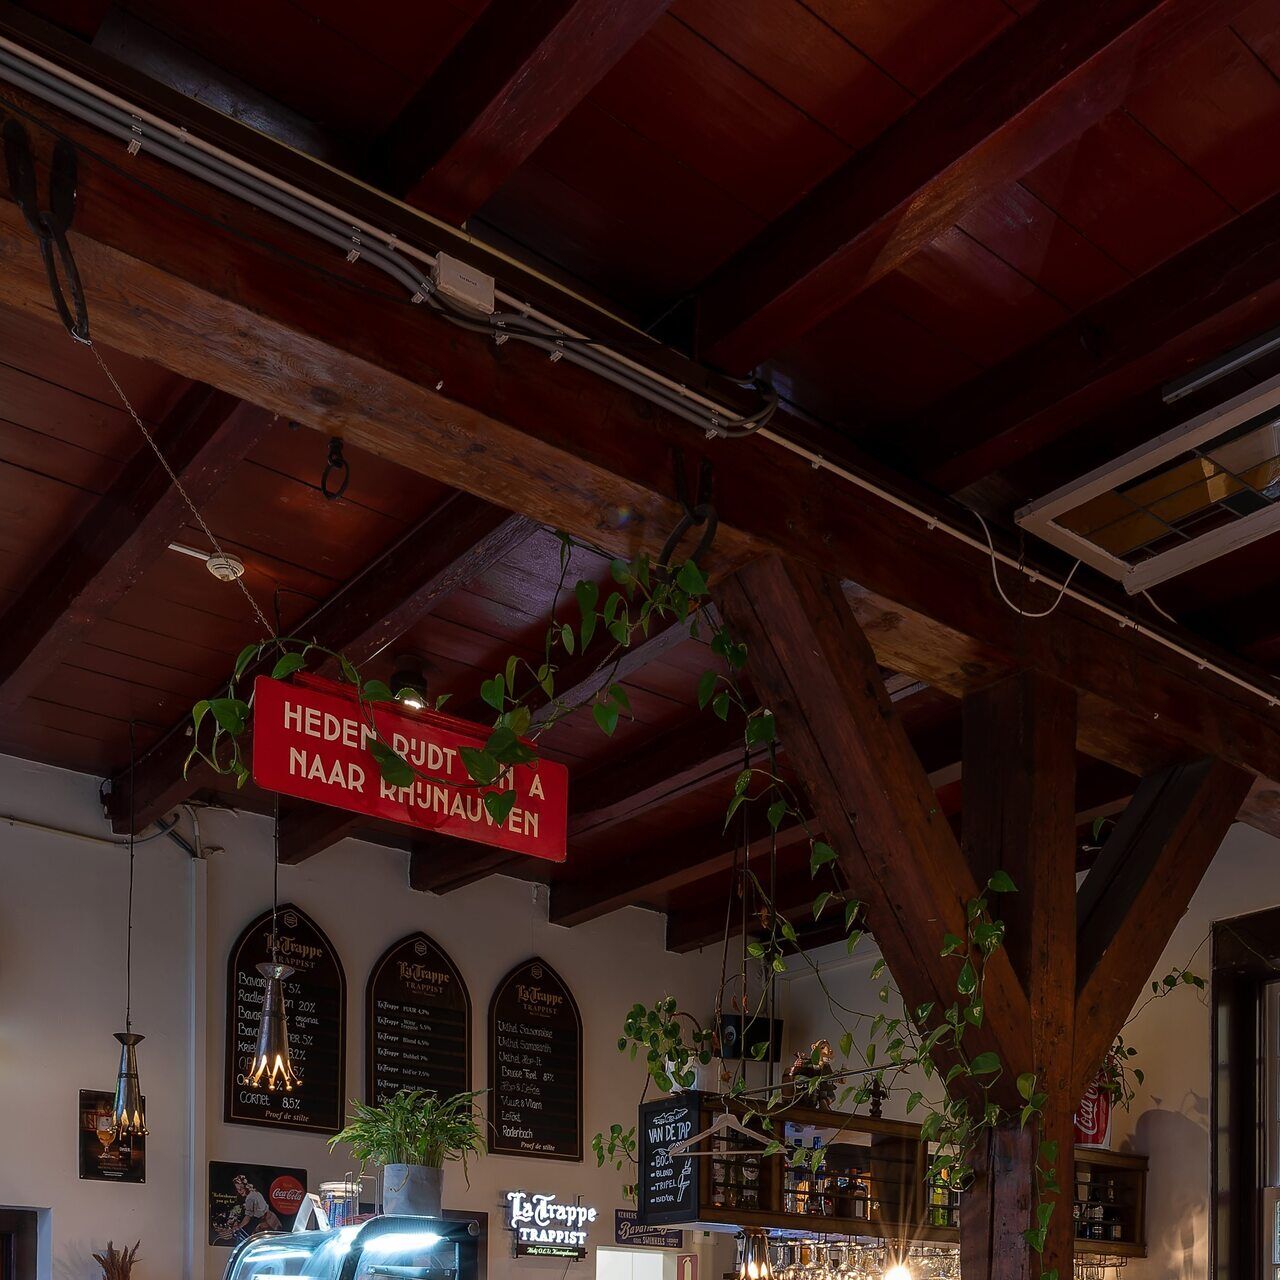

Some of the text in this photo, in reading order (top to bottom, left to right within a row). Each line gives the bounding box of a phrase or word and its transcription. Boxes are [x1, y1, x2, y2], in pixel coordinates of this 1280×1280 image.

[284, 701, 376, 751] HEDEN
[528, 774, 545, 801] A
[289, 747, 365, 793] NAAR
[412, 963, 450, 985] Trappe
[405, 981, 444, 994] TRAPPIST
[238, 989, 265, 1004] Radle
[529, 986, 563, 1006] Trappe
[523, 1003, 557, 1015] TRAPPIST
[265, 1110, 310, 1123] Proef de stilte
[502, 1124, 533, 1139] Rodenbach
[648, 1121, 692, 1144] VAN DE TAP
[520, 1141, 535, 1150] Proef
[655, 1154, 674, 1168] BOCK
[655, 1168, 674, 1178] BLOND
[655, 1179, 678, 1191] TRIPEL
[507, 1192, 597, 1228] La Trappe
[519, 1227, 587, 1245] TRAPPIST
